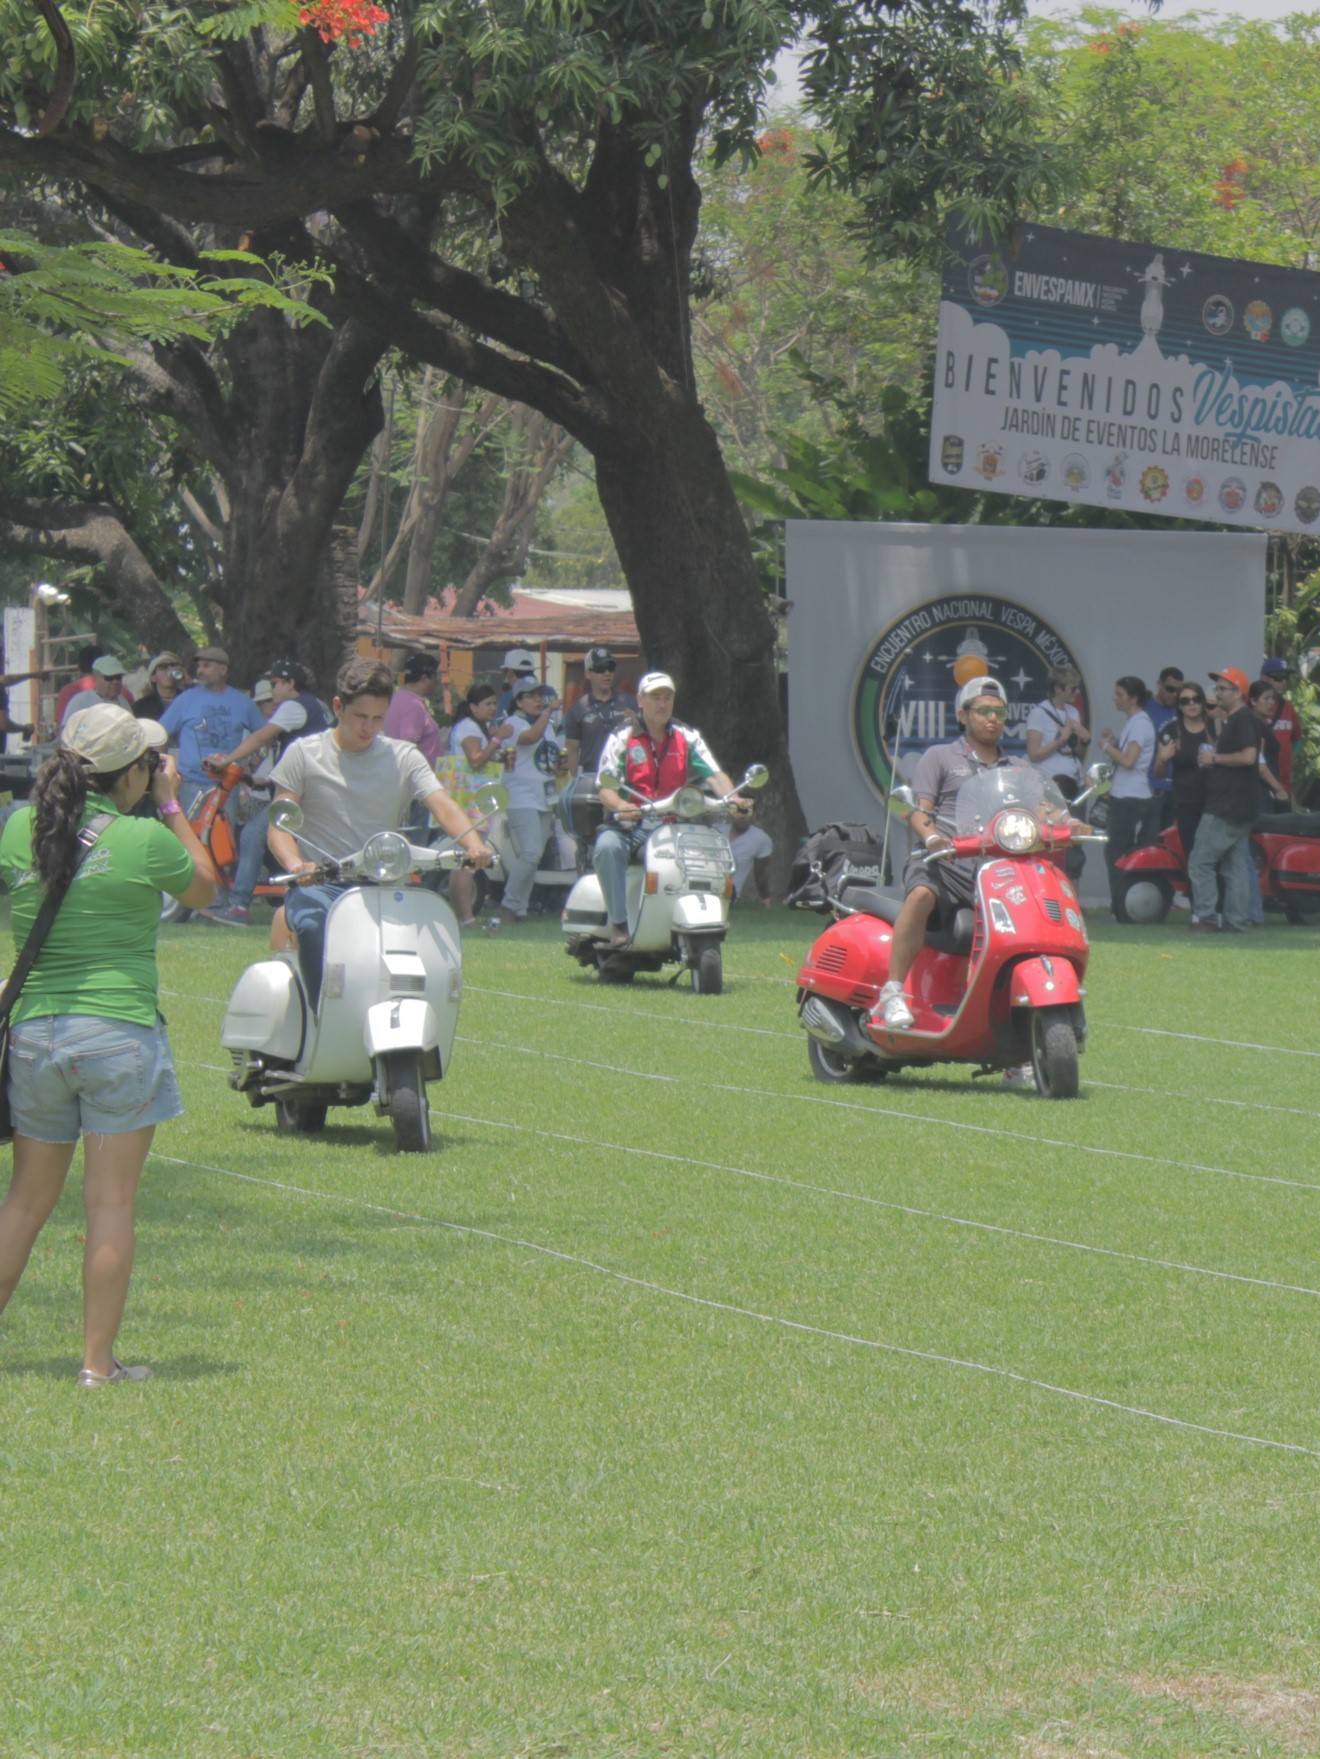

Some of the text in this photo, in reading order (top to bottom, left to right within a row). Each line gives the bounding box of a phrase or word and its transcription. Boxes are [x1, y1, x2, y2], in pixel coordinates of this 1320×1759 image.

[1014, 270, 1096, 308] ENVESPAMX
[943, 350, 1185, 424] BIENVENIDOS
[1001, 406, 1279, 470] JARDÍN DE EVENTOS LA MORELENSE
[870, 600, 1073, 674] ENCUENTRO NACIONAL VESPA MÉXIC
[899, 700, 945, 739] VIII
